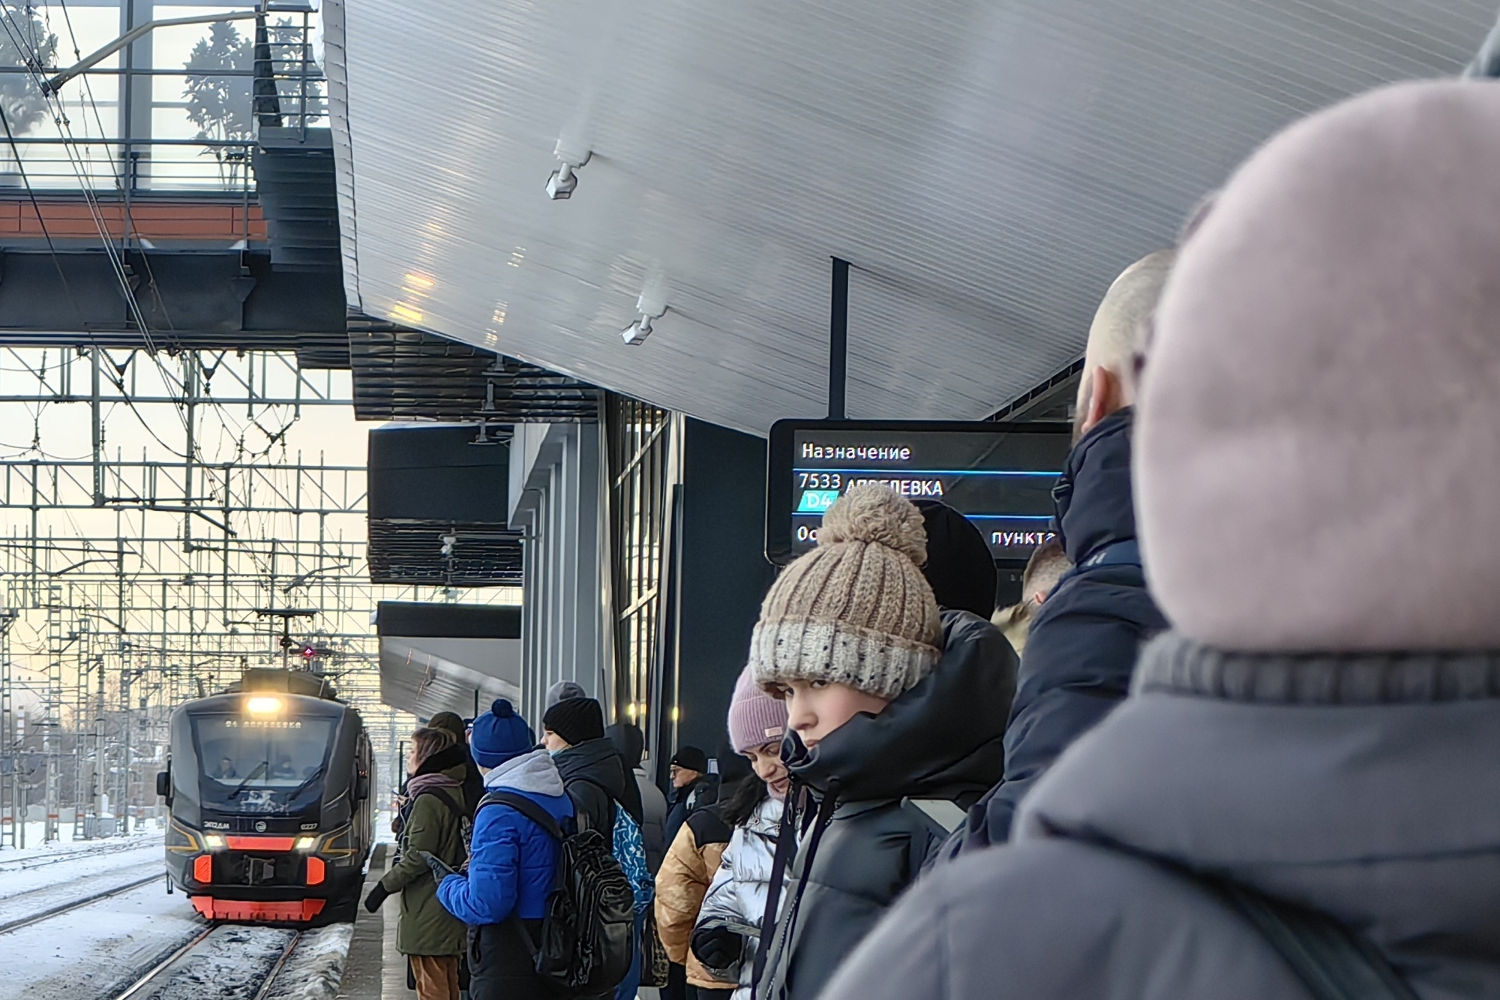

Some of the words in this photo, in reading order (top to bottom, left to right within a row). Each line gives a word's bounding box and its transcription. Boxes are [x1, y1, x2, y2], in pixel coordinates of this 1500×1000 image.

[802, 443, 911, 460] Назначение
[799, 473, 841, 489] 7533
[845, 479, 943, 496] АЛЕВКА
[807, 493, 833, 508] D4
